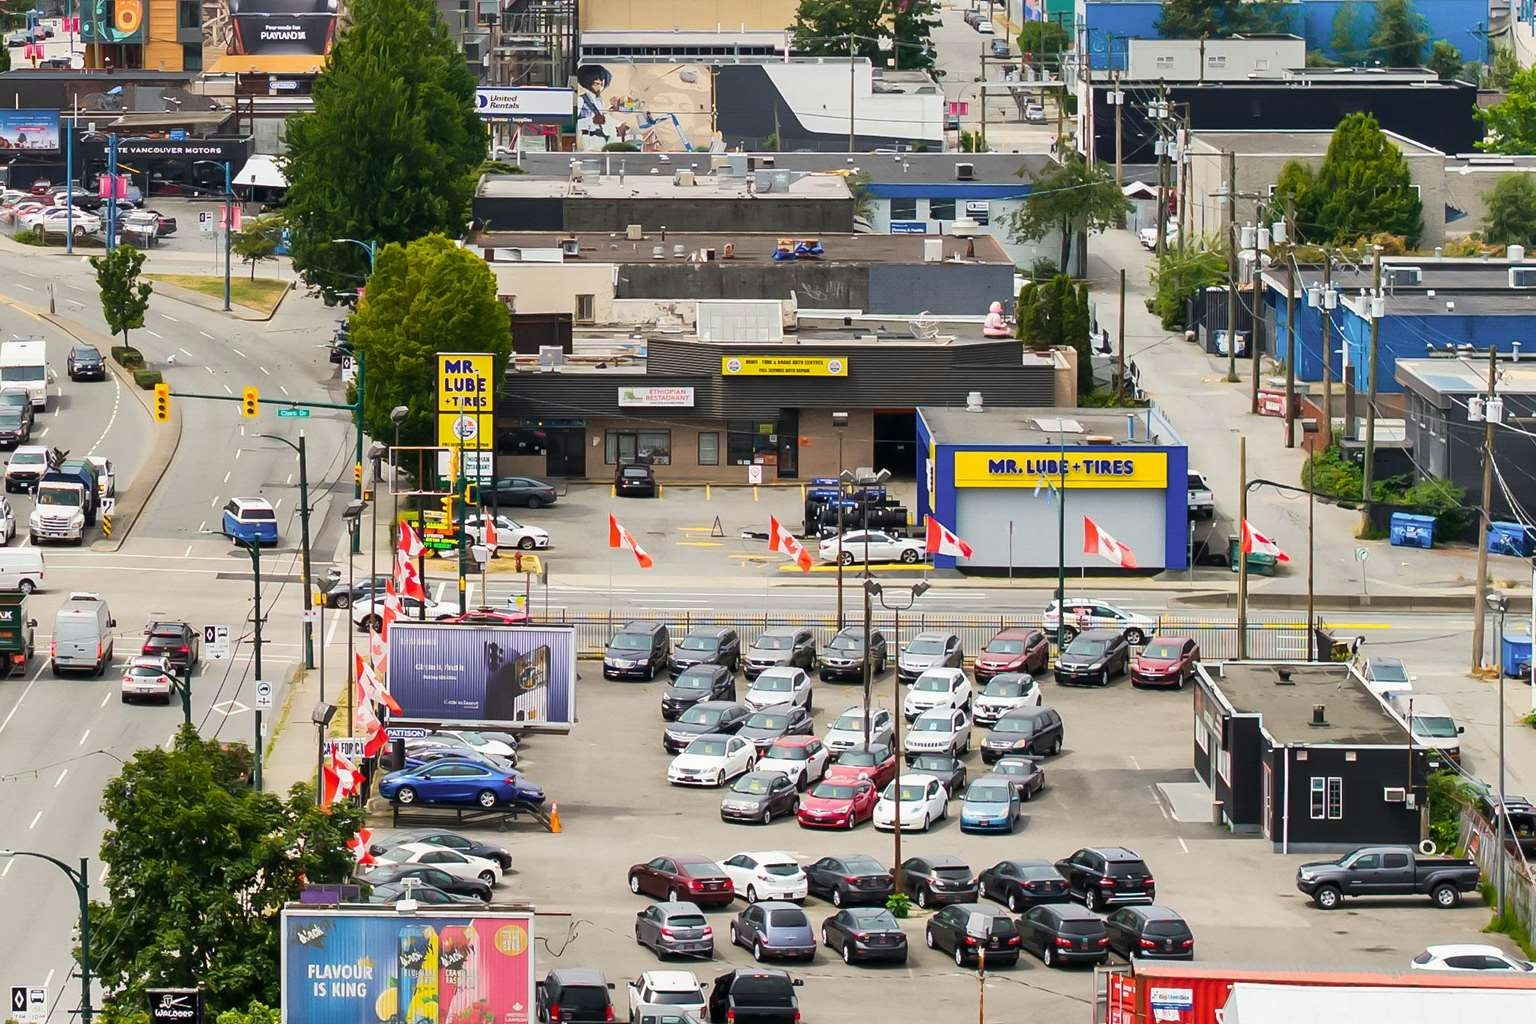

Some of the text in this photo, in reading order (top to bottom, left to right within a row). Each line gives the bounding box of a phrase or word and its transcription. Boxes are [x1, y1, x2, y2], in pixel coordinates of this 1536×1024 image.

[444, 360, 479, 374] MR.
[444, 377, 487, 392] LUBE
[452, 396, 487, 407] TIRES
[988, 459, 1023, 474] MR.
[1026, 459, 1069, 474] LUBE
[1082, 459, 1134, 474] TIRES
[387, 729, 424, 737] PATTISON
[341, 742, 354, 755] FOR
[307, 964, 374, 980] FLAVOUR
[313, 982, 368, 997] IS KING
